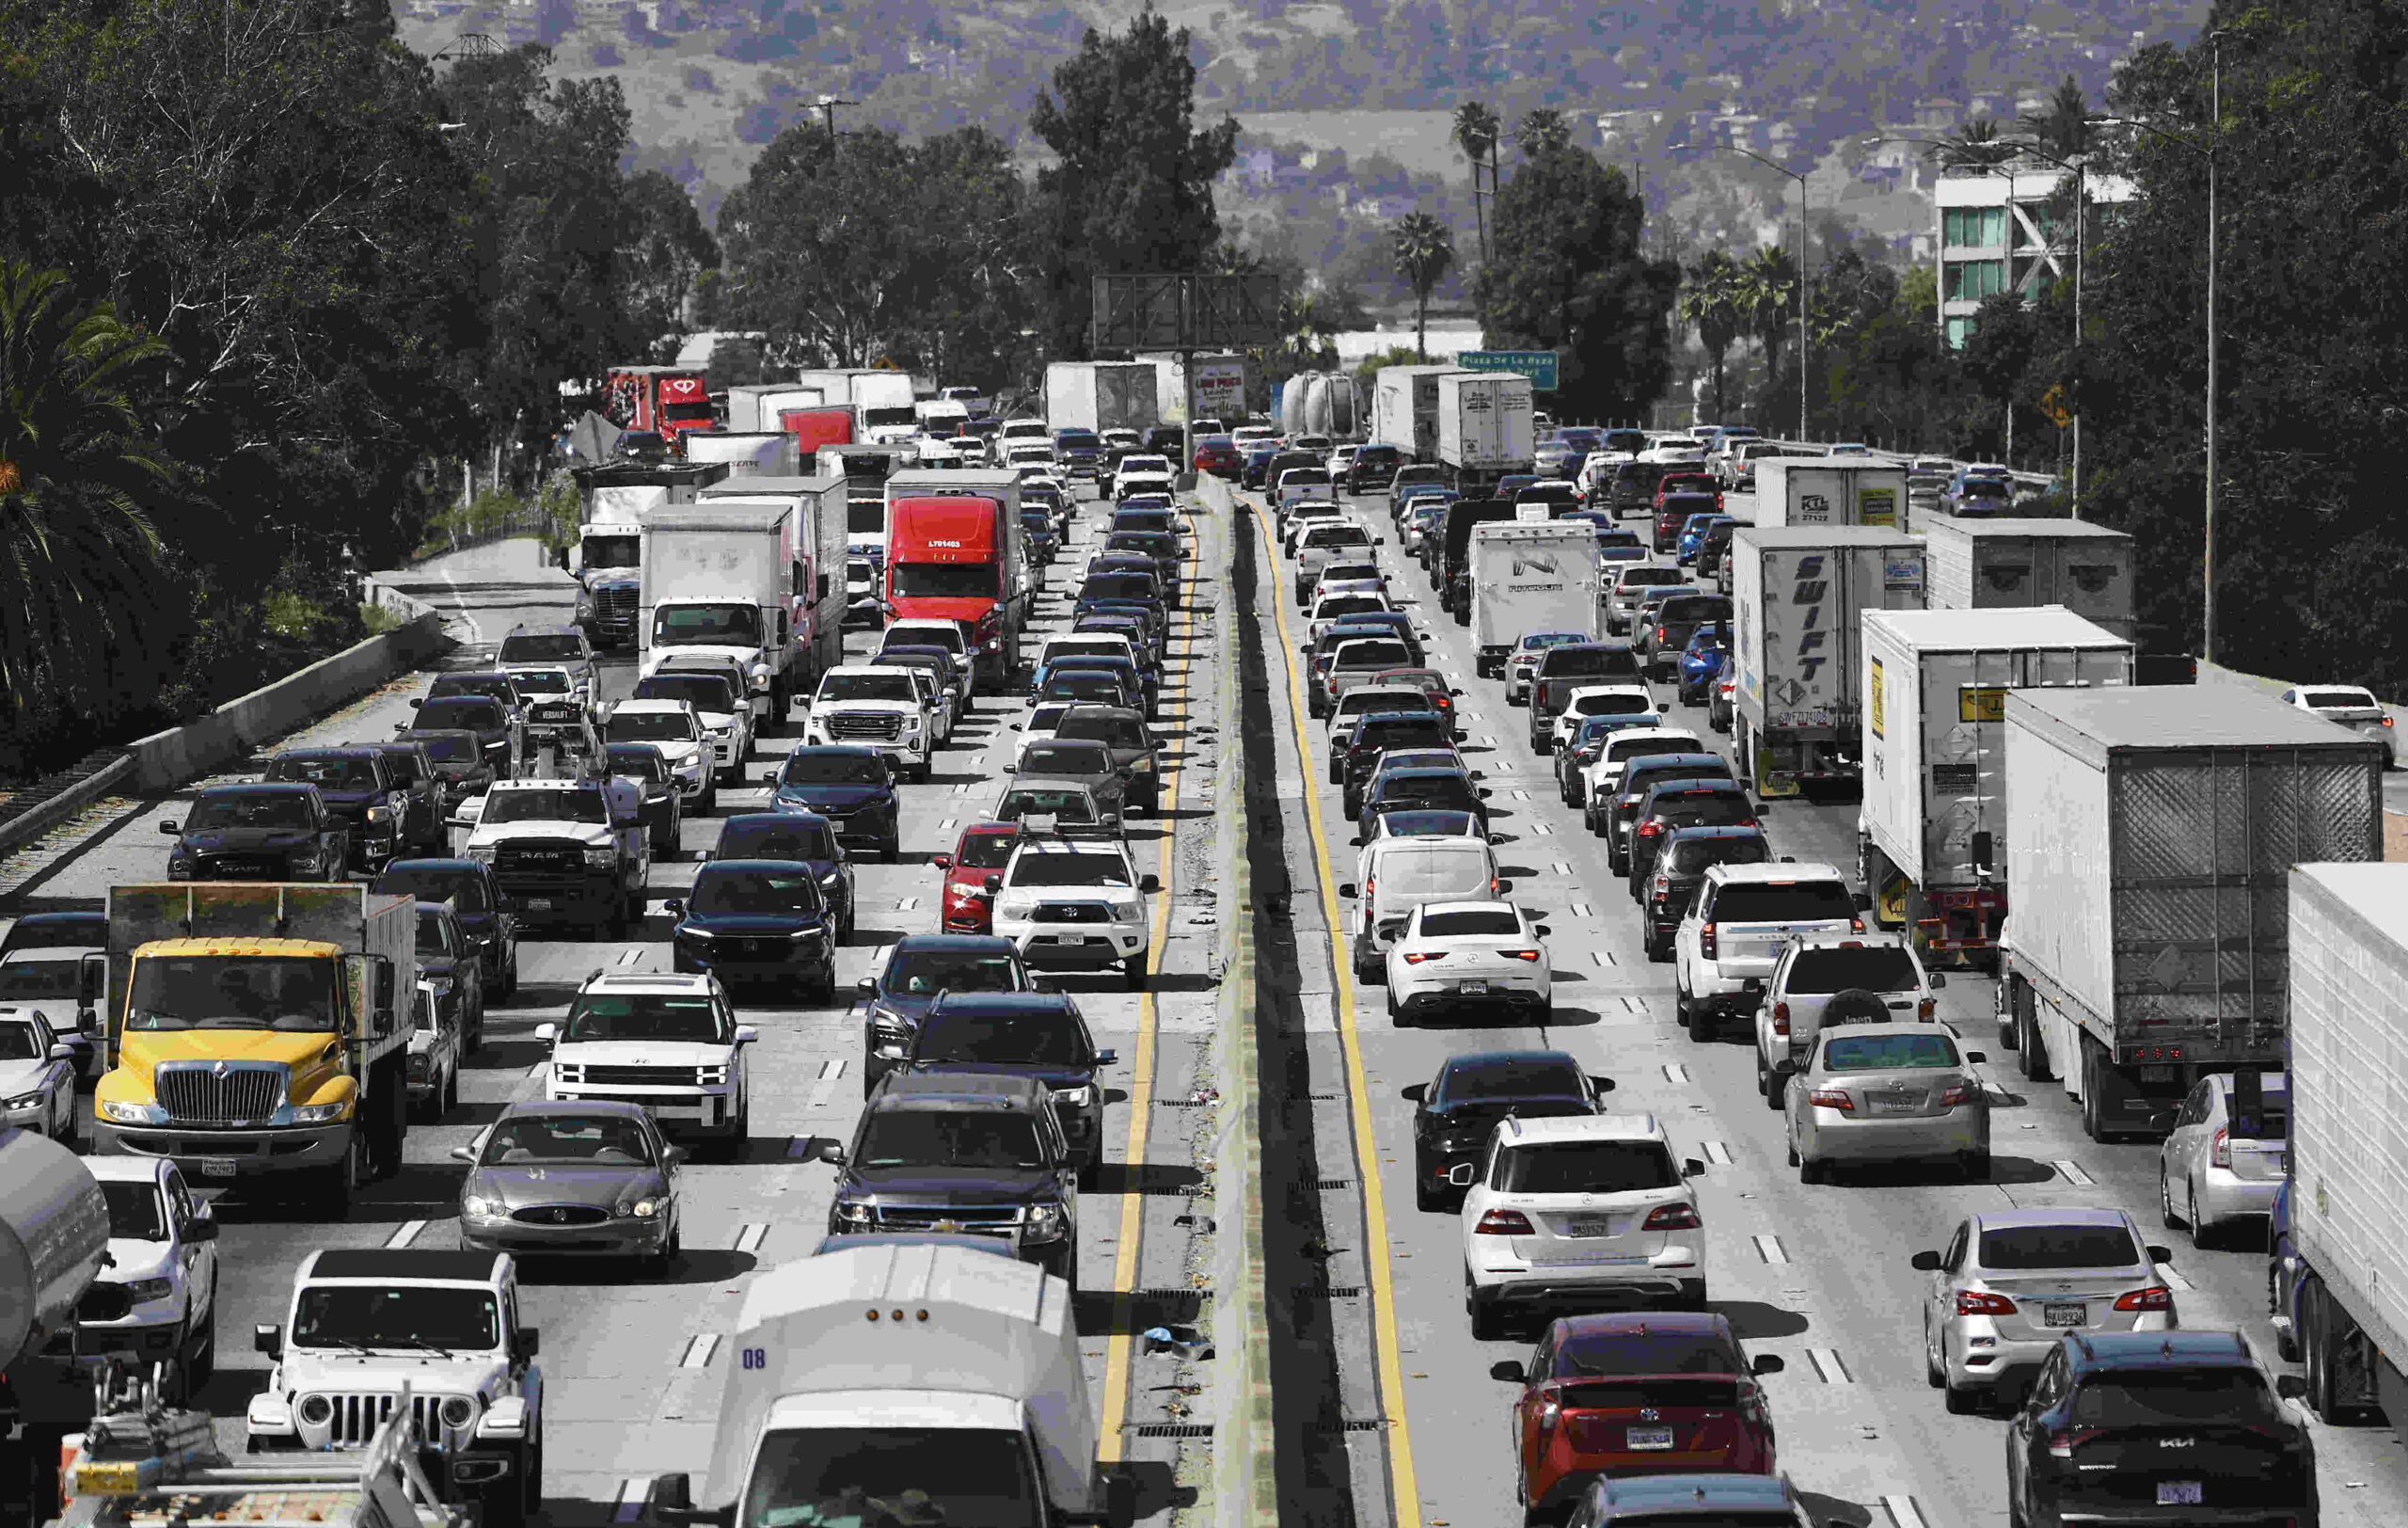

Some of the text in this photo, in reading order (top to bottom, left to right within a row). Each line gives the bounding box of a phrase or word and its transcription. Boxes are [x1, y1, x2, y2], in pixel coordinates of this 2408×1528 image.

[1792, 555, 1828, 681] SWIFT
[1840, 1015, 1872, 1026] Jeep
[742, 1348, 766, 1370] 08
